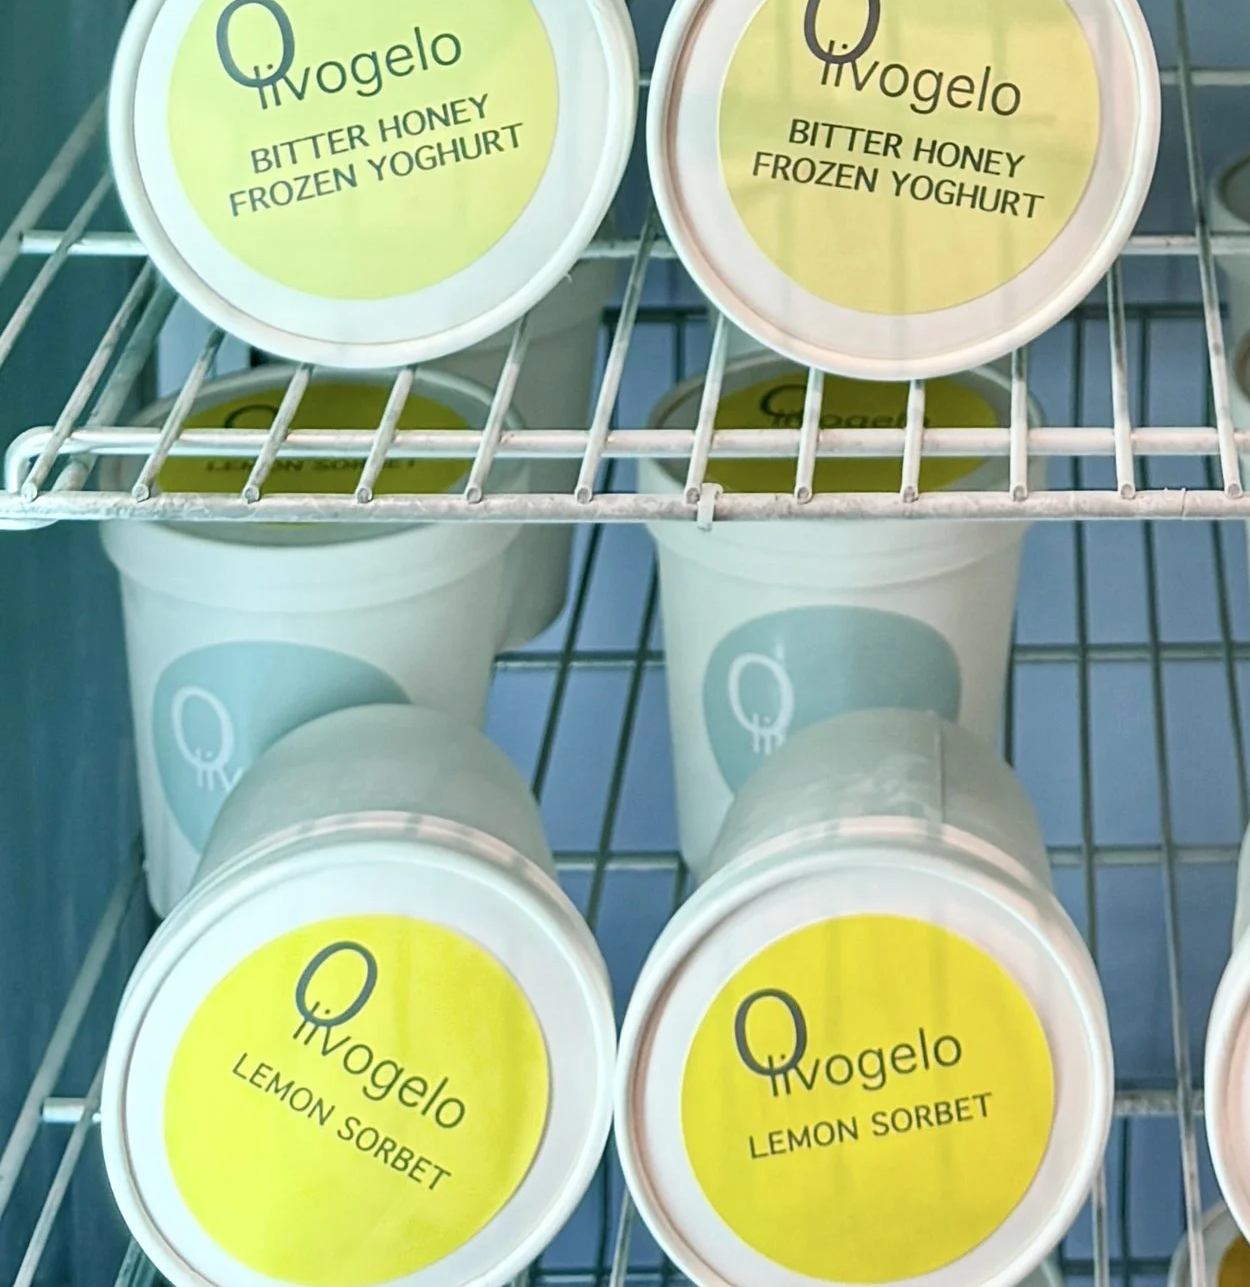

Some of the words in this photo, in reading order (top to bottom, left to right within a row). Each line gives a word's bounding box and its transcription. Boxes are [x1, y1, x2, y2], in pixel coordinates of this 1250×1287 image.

[228, 164, 358, 219] FROZEN
[367, 122, 525, 185] YOGHURT
[249, 119, 371, 175] BITTER
[378, 93, 490, 145] HONEY
[788, 116, 903, 156] BITTER
[911, 133, 1025, 181] HONEY
[752, 151, 880, 196] FROZEN
[891, 170, 1045, 221] YOGHURT
[230, 1051, 333, 1129] LEMON
[335, 1112, 452, 1192] SORBET
[747, 1117, 859, 1160] LEMON
[870, 1091, 993, 1135] SORBET
